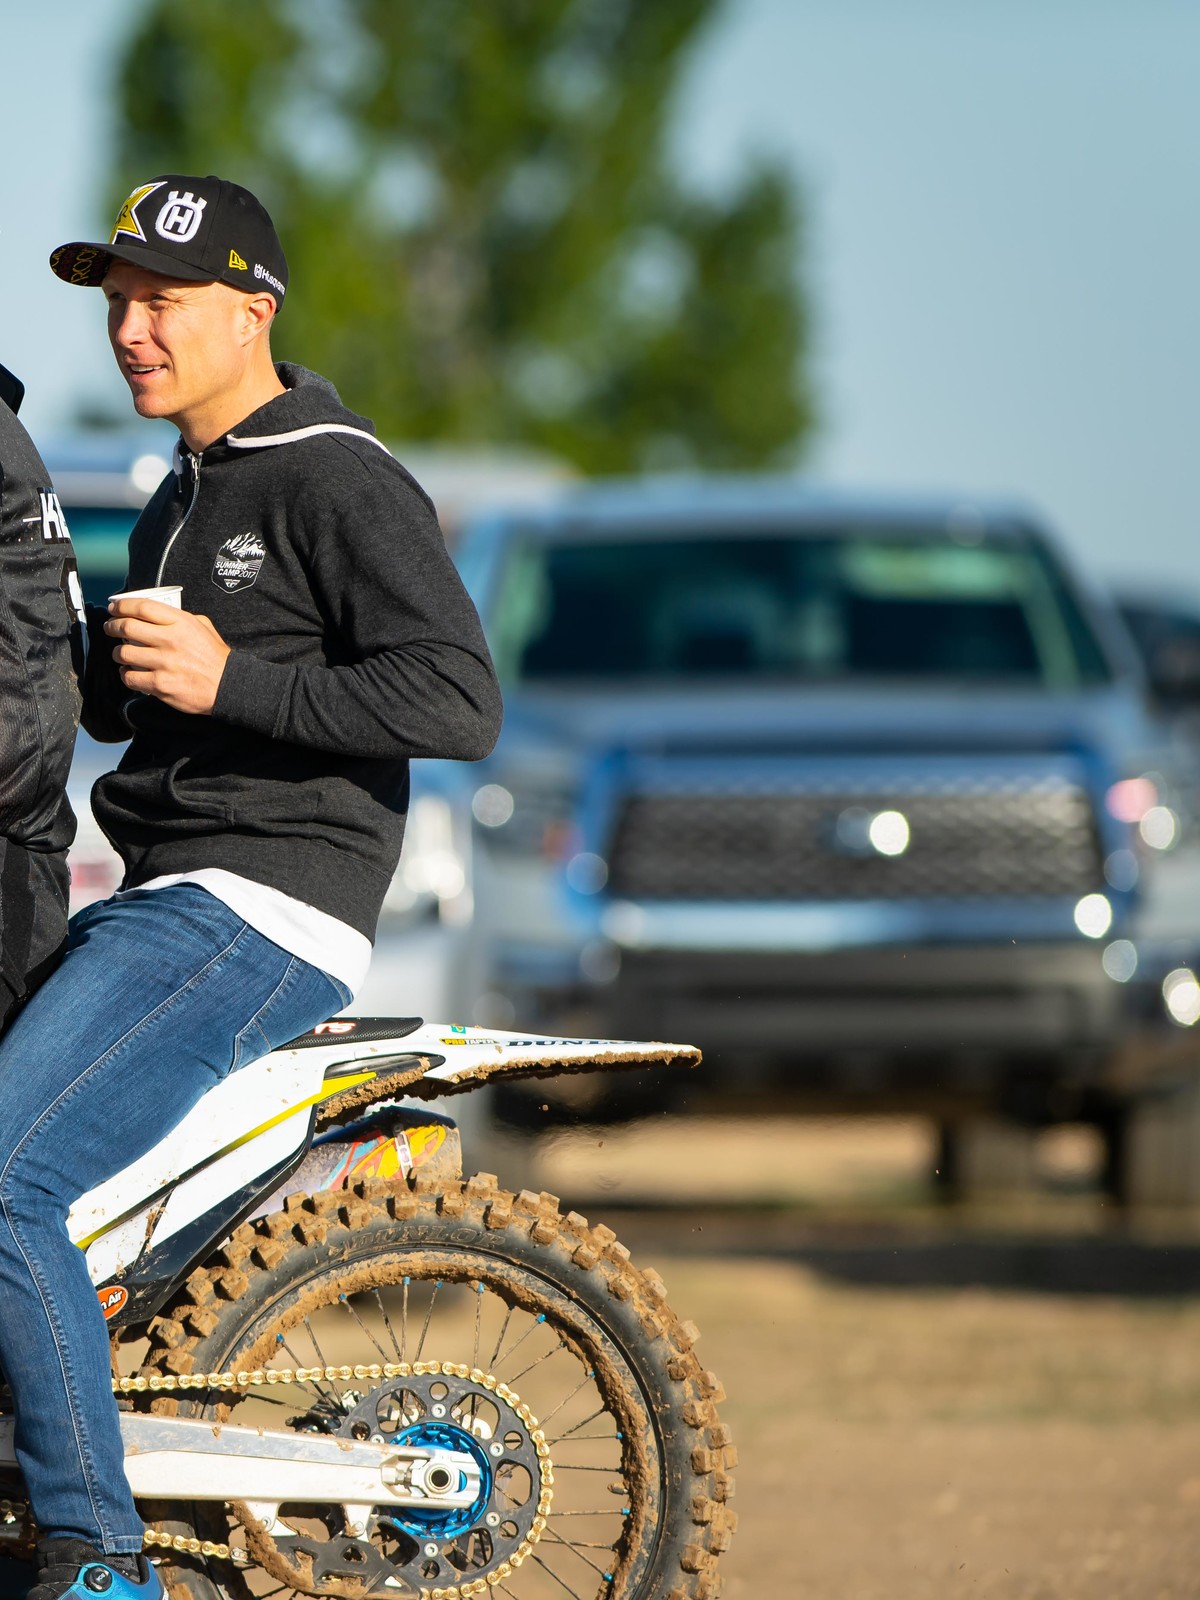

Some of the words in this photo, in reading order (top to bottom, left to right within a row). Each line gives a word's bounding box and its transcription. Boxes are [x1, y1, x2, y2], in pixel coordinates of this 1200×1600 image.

[215, 561, 249, 571] SUMMER
[506, 1040, 646, 1048] DUNL
[108, 1290, 123, 1307] Air
